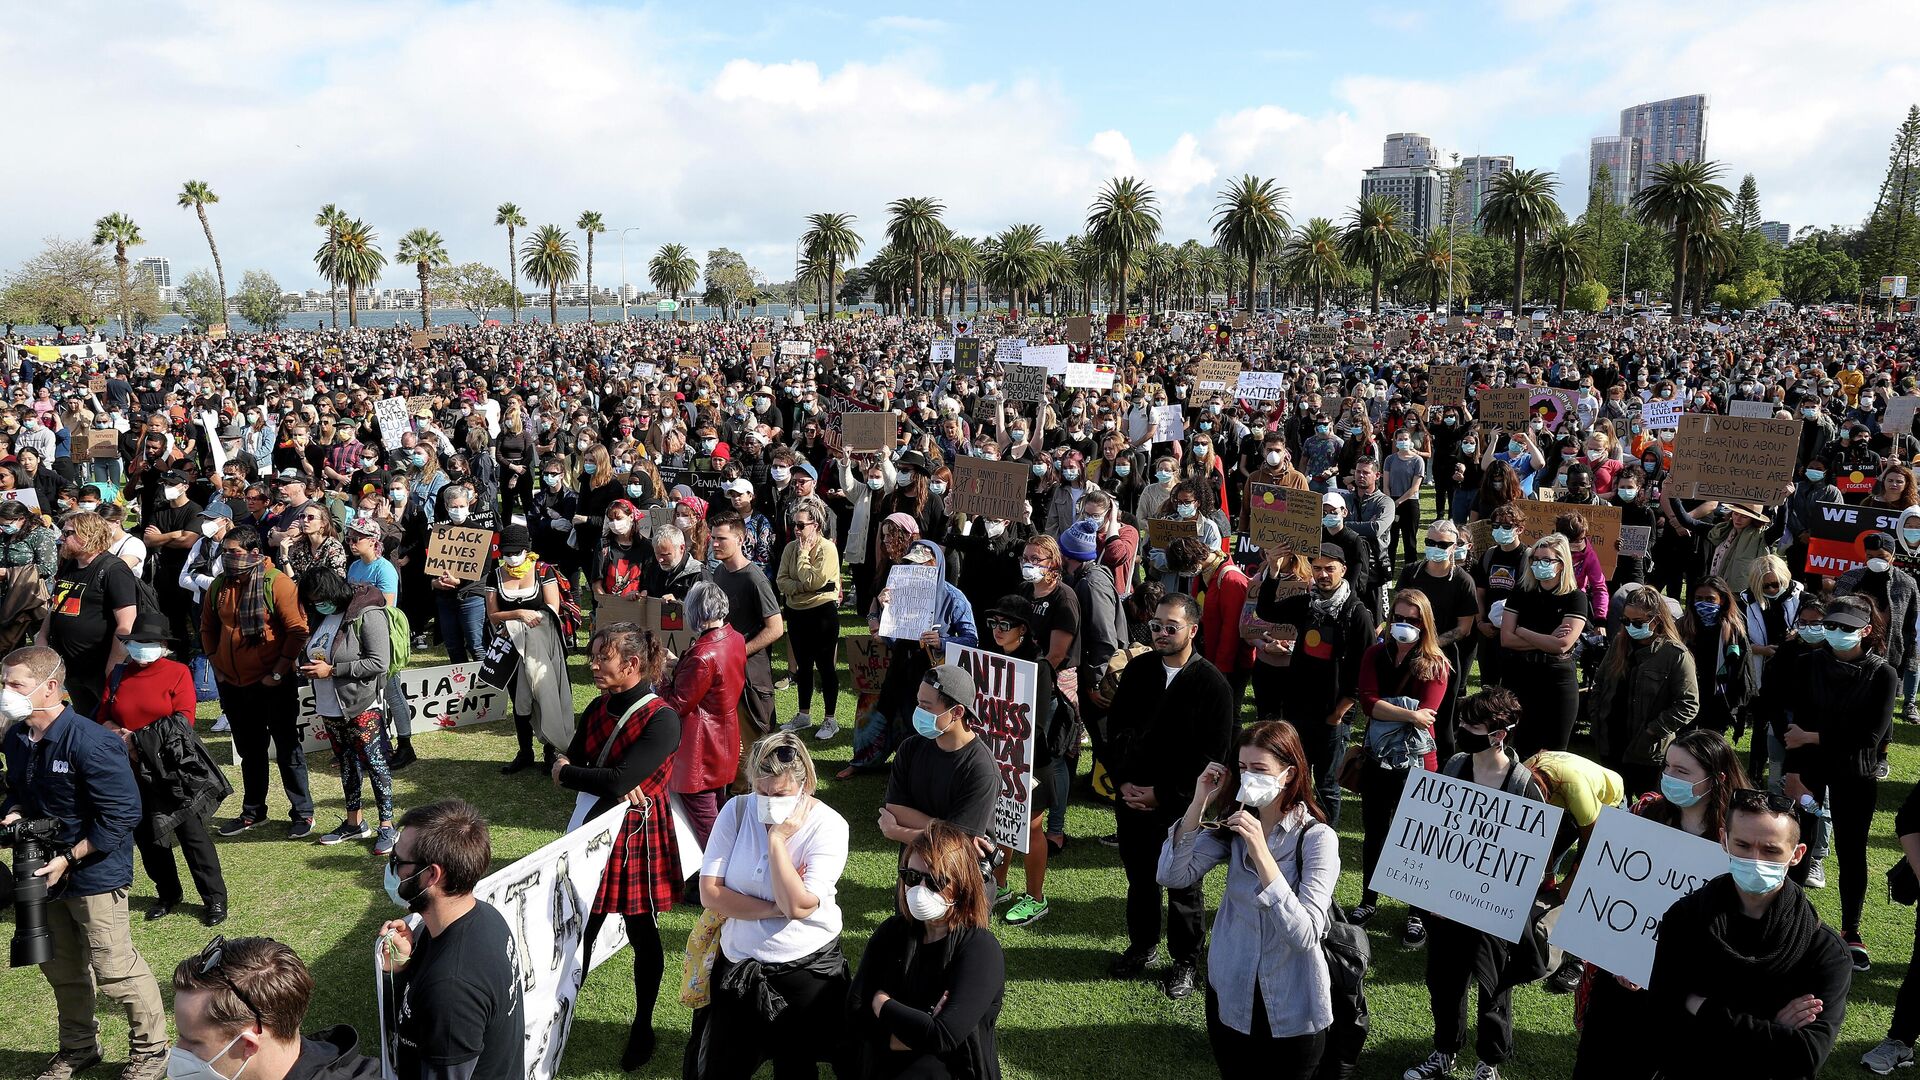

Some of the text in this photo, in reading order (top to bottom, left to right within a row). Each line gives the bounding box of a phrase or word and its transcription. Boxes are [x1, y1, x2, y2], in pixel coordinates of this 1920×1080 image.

[958, 342, 976, 350] BLM
[1016, 365, 1040, 374] STOP
[1004, 372, 1042, 385] KILLING
[1003, 382, 1044, 393] ABORIGINAL
[1239, 386, 1278, 399] MATTER
[1008, 392, 1038, 400] PEOPLE
[378, 398, 399, 410] BLACK
[382, 404, 402, 416] LIVES
[1492, 401, 1518, 410] PROTEST
[1564, 402, 1572, 411] YO
[380, 410, 408, 422] MATTER
[1482, 411, 1524, 420] WHATS THIS
[1650, 416, 1677, 424] MATTER!
[1686, 418, 1700, 429] IF
[1713, 418, 1758, 433] YOU'RE
[1680, 436, 1696, 446] OF
[1753, 440, 1788, 452] ABOUT
[956, 467, 1012, 483] THERE CANNOT BE
[1674, 462, 1694, 471] HOW
[1729, 467, 1762, 479] PEOPLE
[1766, 471, 1789, 482] ARE
[971, 478, 1022, 500] 437 VICTIMS &
[1674, 482, 1689, 492] OF
[6, 492, 18, 500] OF
[952, 493, 1020, 518] NO PERPETRATORS
[484, 520, 494, 528] BE
[1254, 513, 1276, 524] WHEN
[1277, 517, 1292, 528] WILL
[1298, 523, 1320, 536] END?
[1822, 507, 1899, 530] WE ST
[1156, 522, 1196, 532] SILENCE
[438, 528, 483, 544] BLACK
[441, 544, 476, 558] LIVES
[427, 557, 478, 573] MATTER
[1810, 554, 1864, 571] WITH
[856, 640, 880, 657] WE
[958, 648, 1016, 703] ANTI
[1006, 800, 1026, 814] MIND
[1410, 776, 1546, 838] AUSTRALIA
[1440, 809, 1504, 843] IS NOT
[1395, 816, 1536, 887] INNOCENT
[1402, 856, 1424, 871] 434
[1597, 840, 1710, 896] NO JUST
[1386, 866, 1431, 891] DEATHS
[1449, 888, 1516, 920] CONVICTIONS
[1578, 886, 1638, 932] NO
